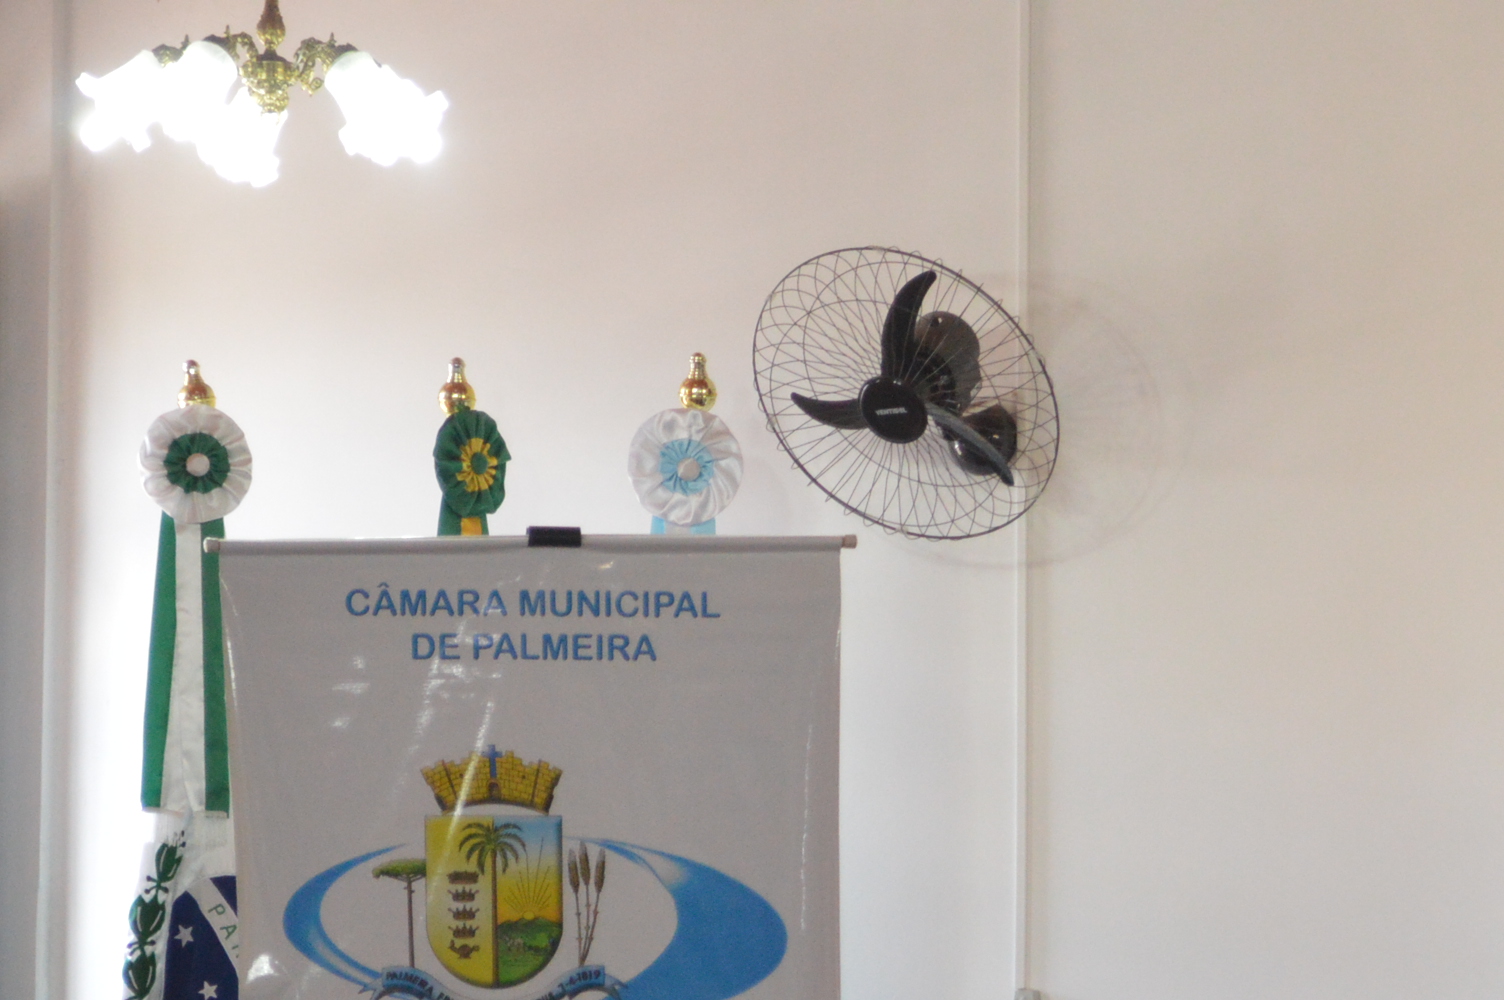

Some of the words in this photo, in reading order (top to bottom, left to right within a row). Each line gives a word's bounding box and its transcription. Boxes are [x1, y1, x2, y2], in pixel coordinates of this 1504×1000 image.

[344, 582, 508, 617] CÂMARA
[519, 589, 721, 619] MUNICIPAL
[411, 633, 461, 661] DE
[473, 633, 657, 661] PALMEIRA
